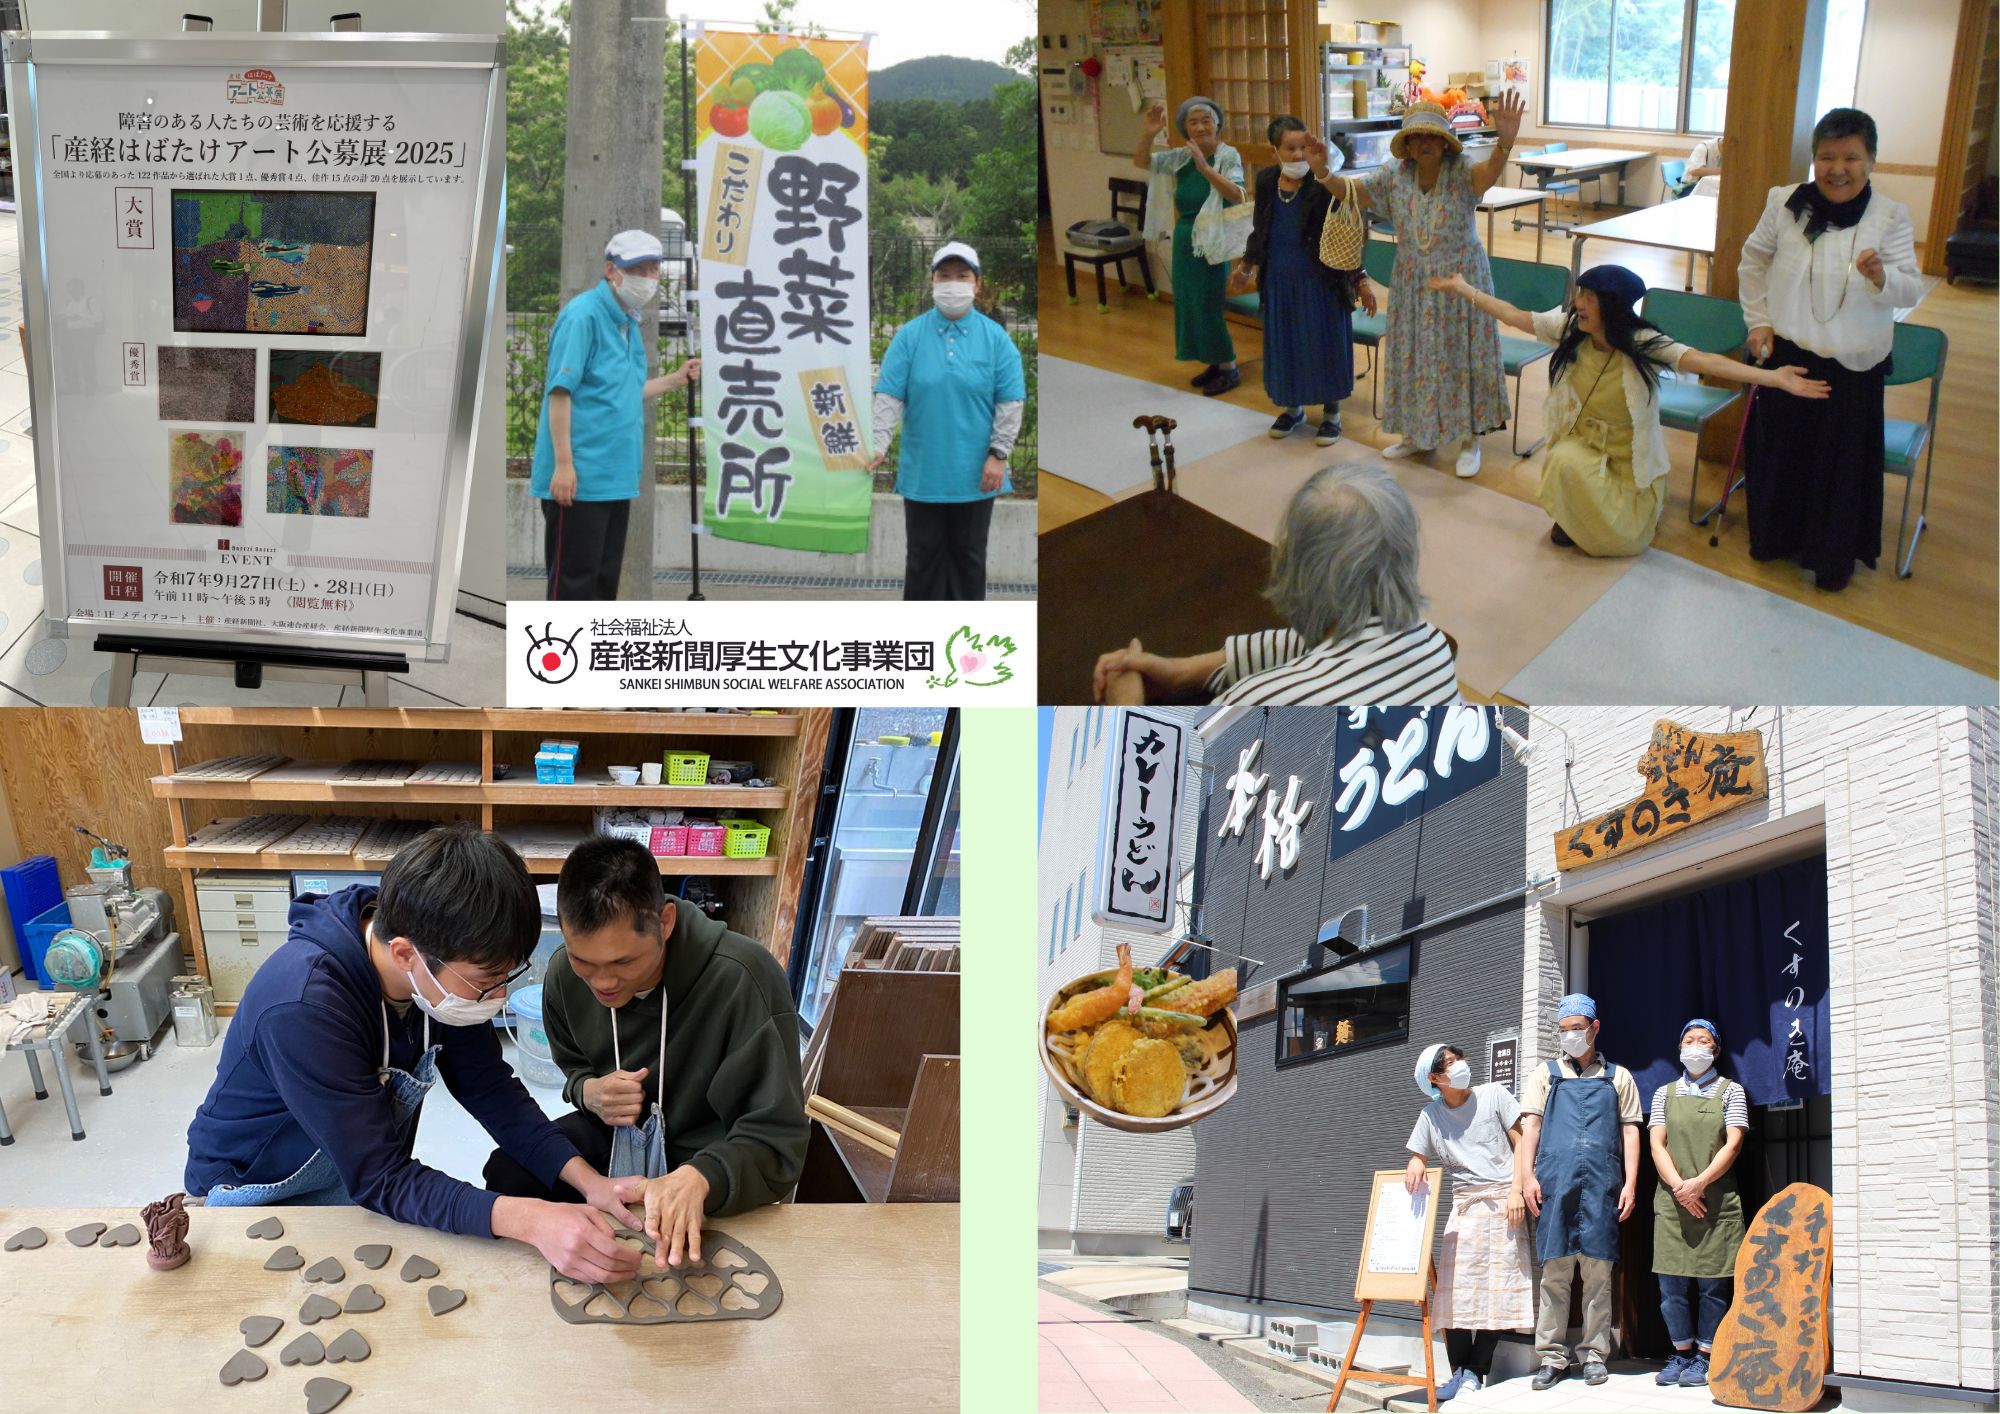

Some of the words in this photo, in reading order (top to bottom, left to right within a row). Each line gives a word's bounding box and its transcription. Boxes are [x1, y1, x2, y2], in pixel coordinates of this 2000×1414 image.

[118, 112, 396, 132] 障害のある人たちの芸術を応援する
[125, 196, 144, 239] 大賞
[715, 151, 750, 254] こだわり
[767, 155, 863, 345] 野菜
[128, 346, 140, 382] 優秀賞
[714, 268, 792, 518] 直売所
[810, 382, 860, 455] 新鮮
[109, 570, 138, 583] 開催
[110, 585, 138, 597] 日程
[221, 554, 273, 566] EVENT
[1121, 729, 1166, 895] カレーうどん
[1218, 739, 1313, 880] 本格
[1335, 706, 1490, 832] うどん
[1567, 743, 1755, 858] くすのき庵
[1781, 920, 1810, 1080] くすのき庵
[1712, 1193, 1797, 1406] くすのき庵
